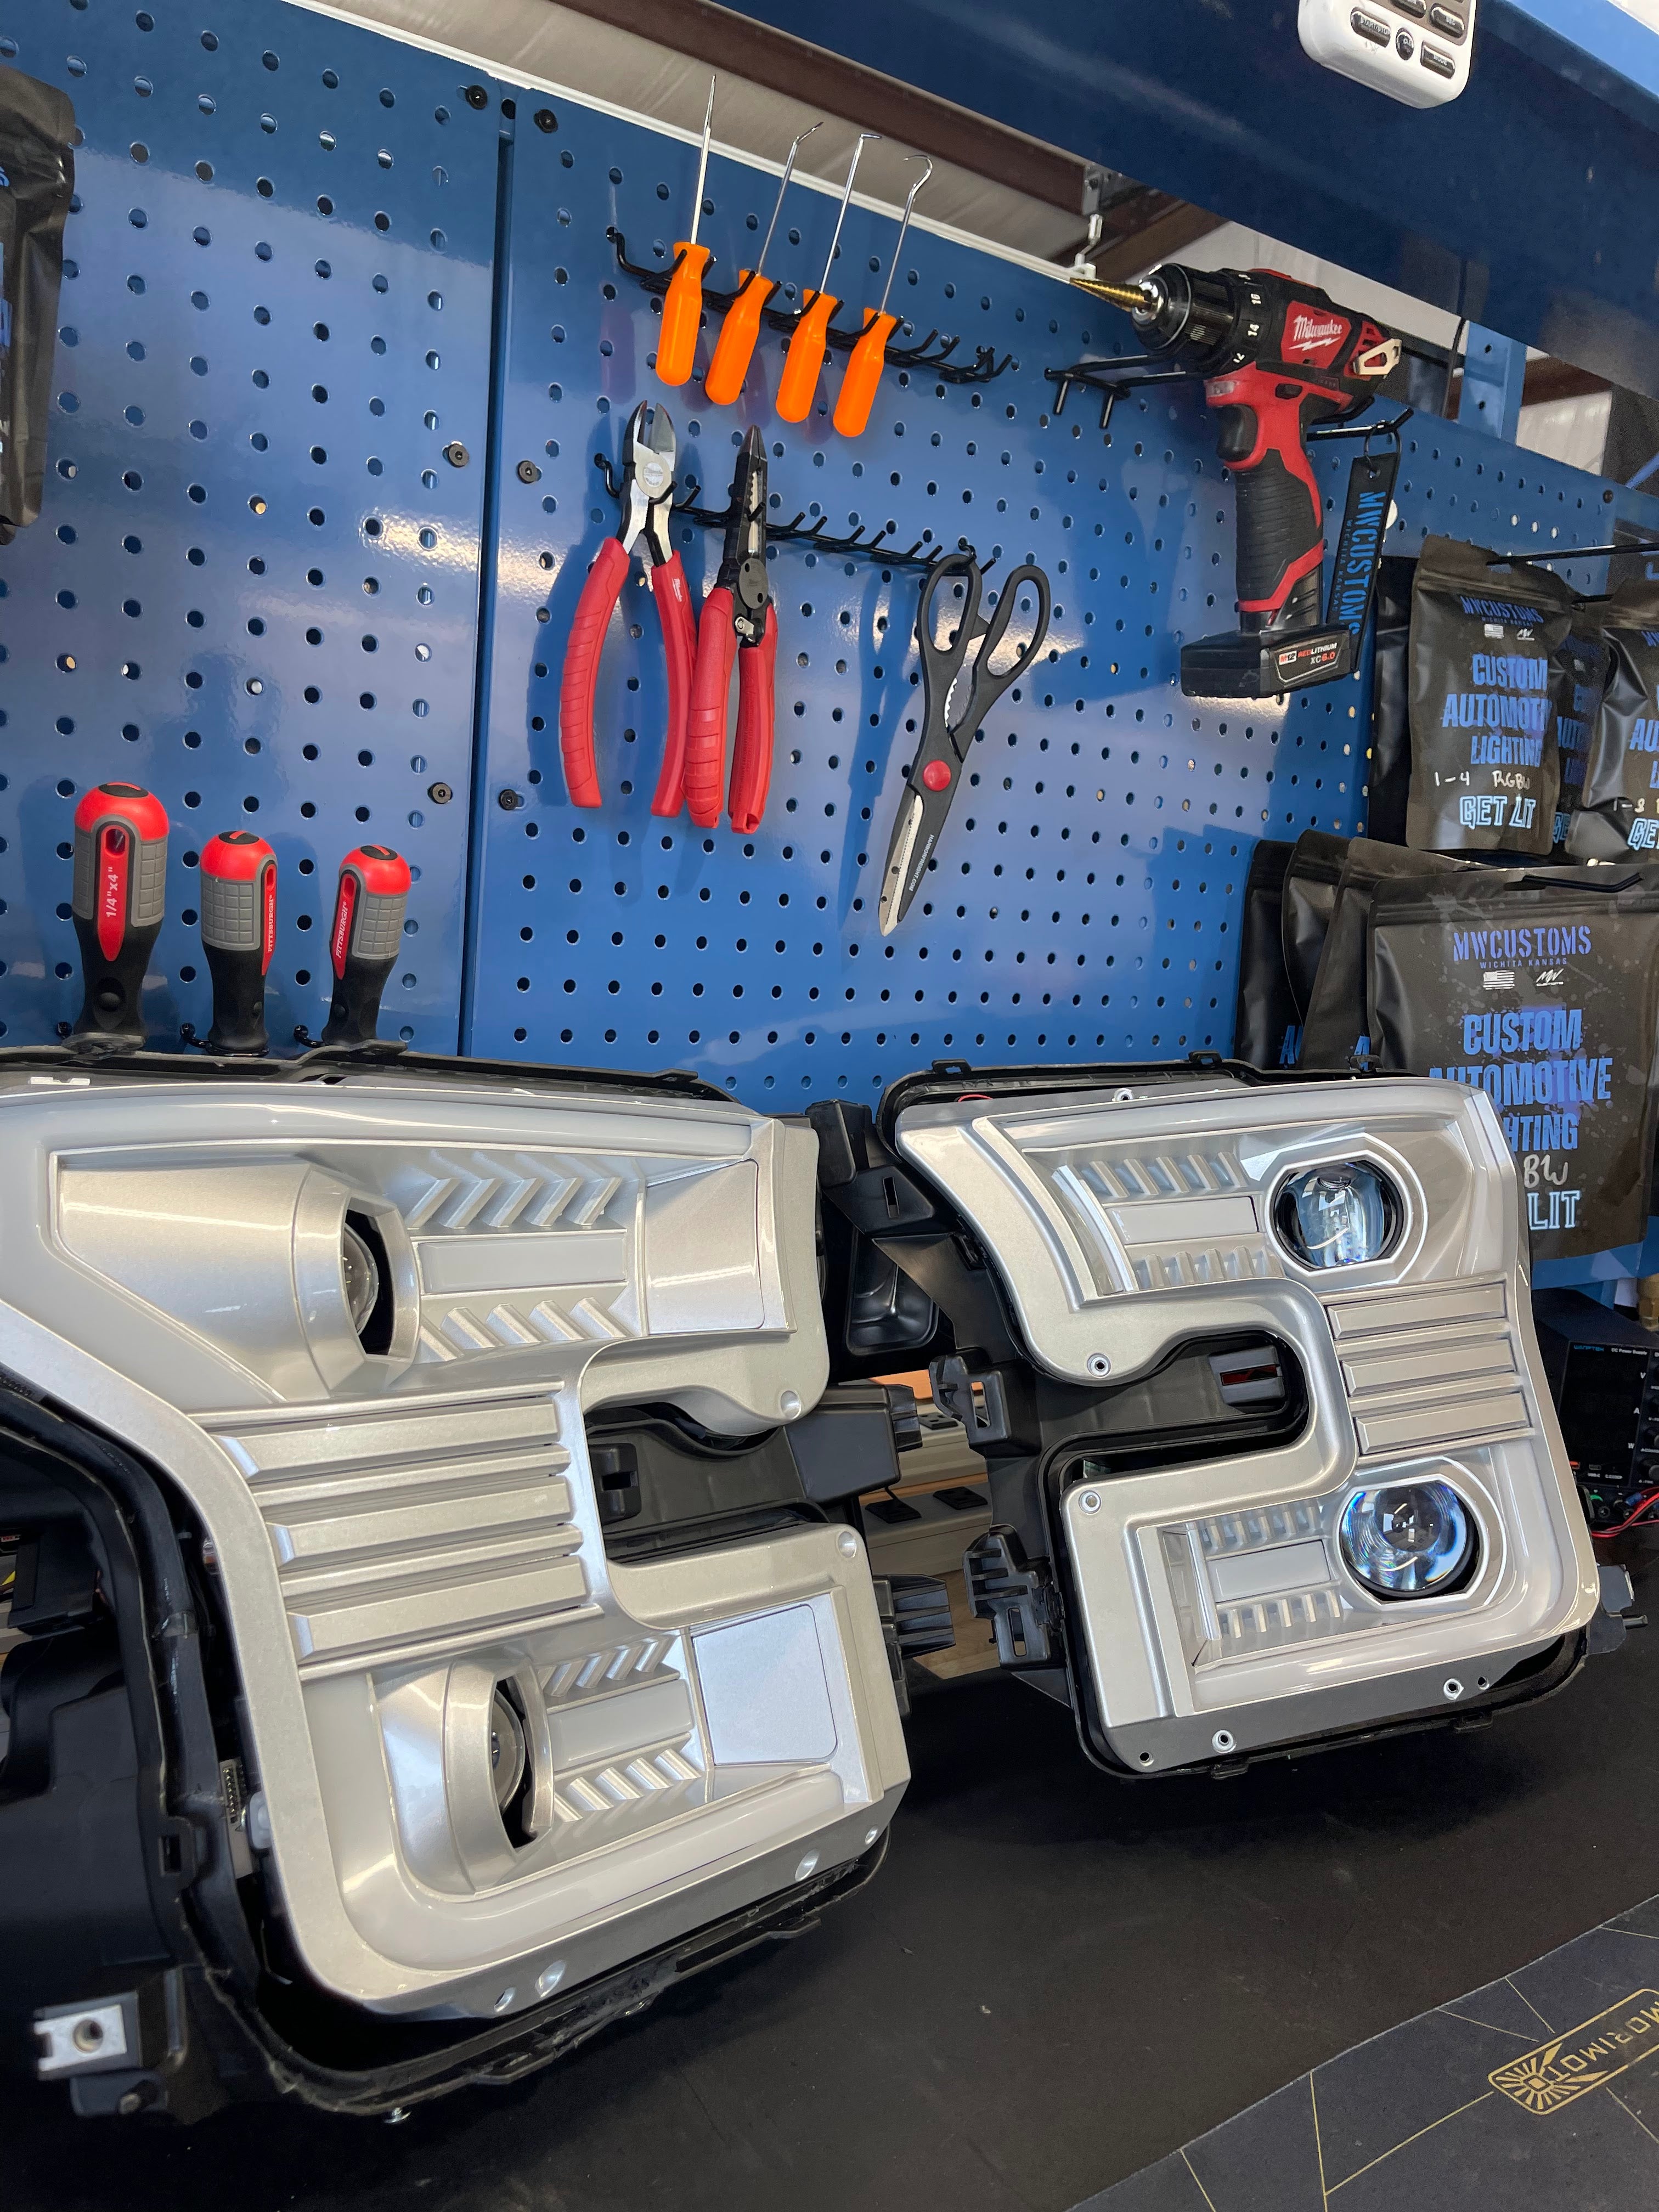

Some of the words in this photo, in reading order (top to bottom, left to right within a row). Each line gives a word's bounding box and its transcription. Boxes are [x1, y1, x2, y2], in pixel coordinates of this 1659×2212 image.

[1247, 324, 1260, 336] 14
[1293, 315, 1343, 341] Milwaukee
[1460, 596, 1544, 623] MWCUSTOMS
[1472, 653, 1548, 691] CUSTOM
[1459, 795, 1508, 830] GET
[1627, 817, 1659, 851] GE
[909, 834, 934, 891] HARBORFREIGHT.COM
[106, 866, 119, 918] 1/4"x4"
[1453, 926, 1592, 962] MWCUSTOMS
[1480, 960, 1522, 969] WICHITA
[1528, 958, 1568, 967] KANSAS
[1464, 1009, 1582, 1055] CUSTOM
[1429, 1057, 1613, 1105] TOMOTIVE
[1503, 1113, 1578, 1152] HTING
[1527, 1189, 1581, 1231] LIT
